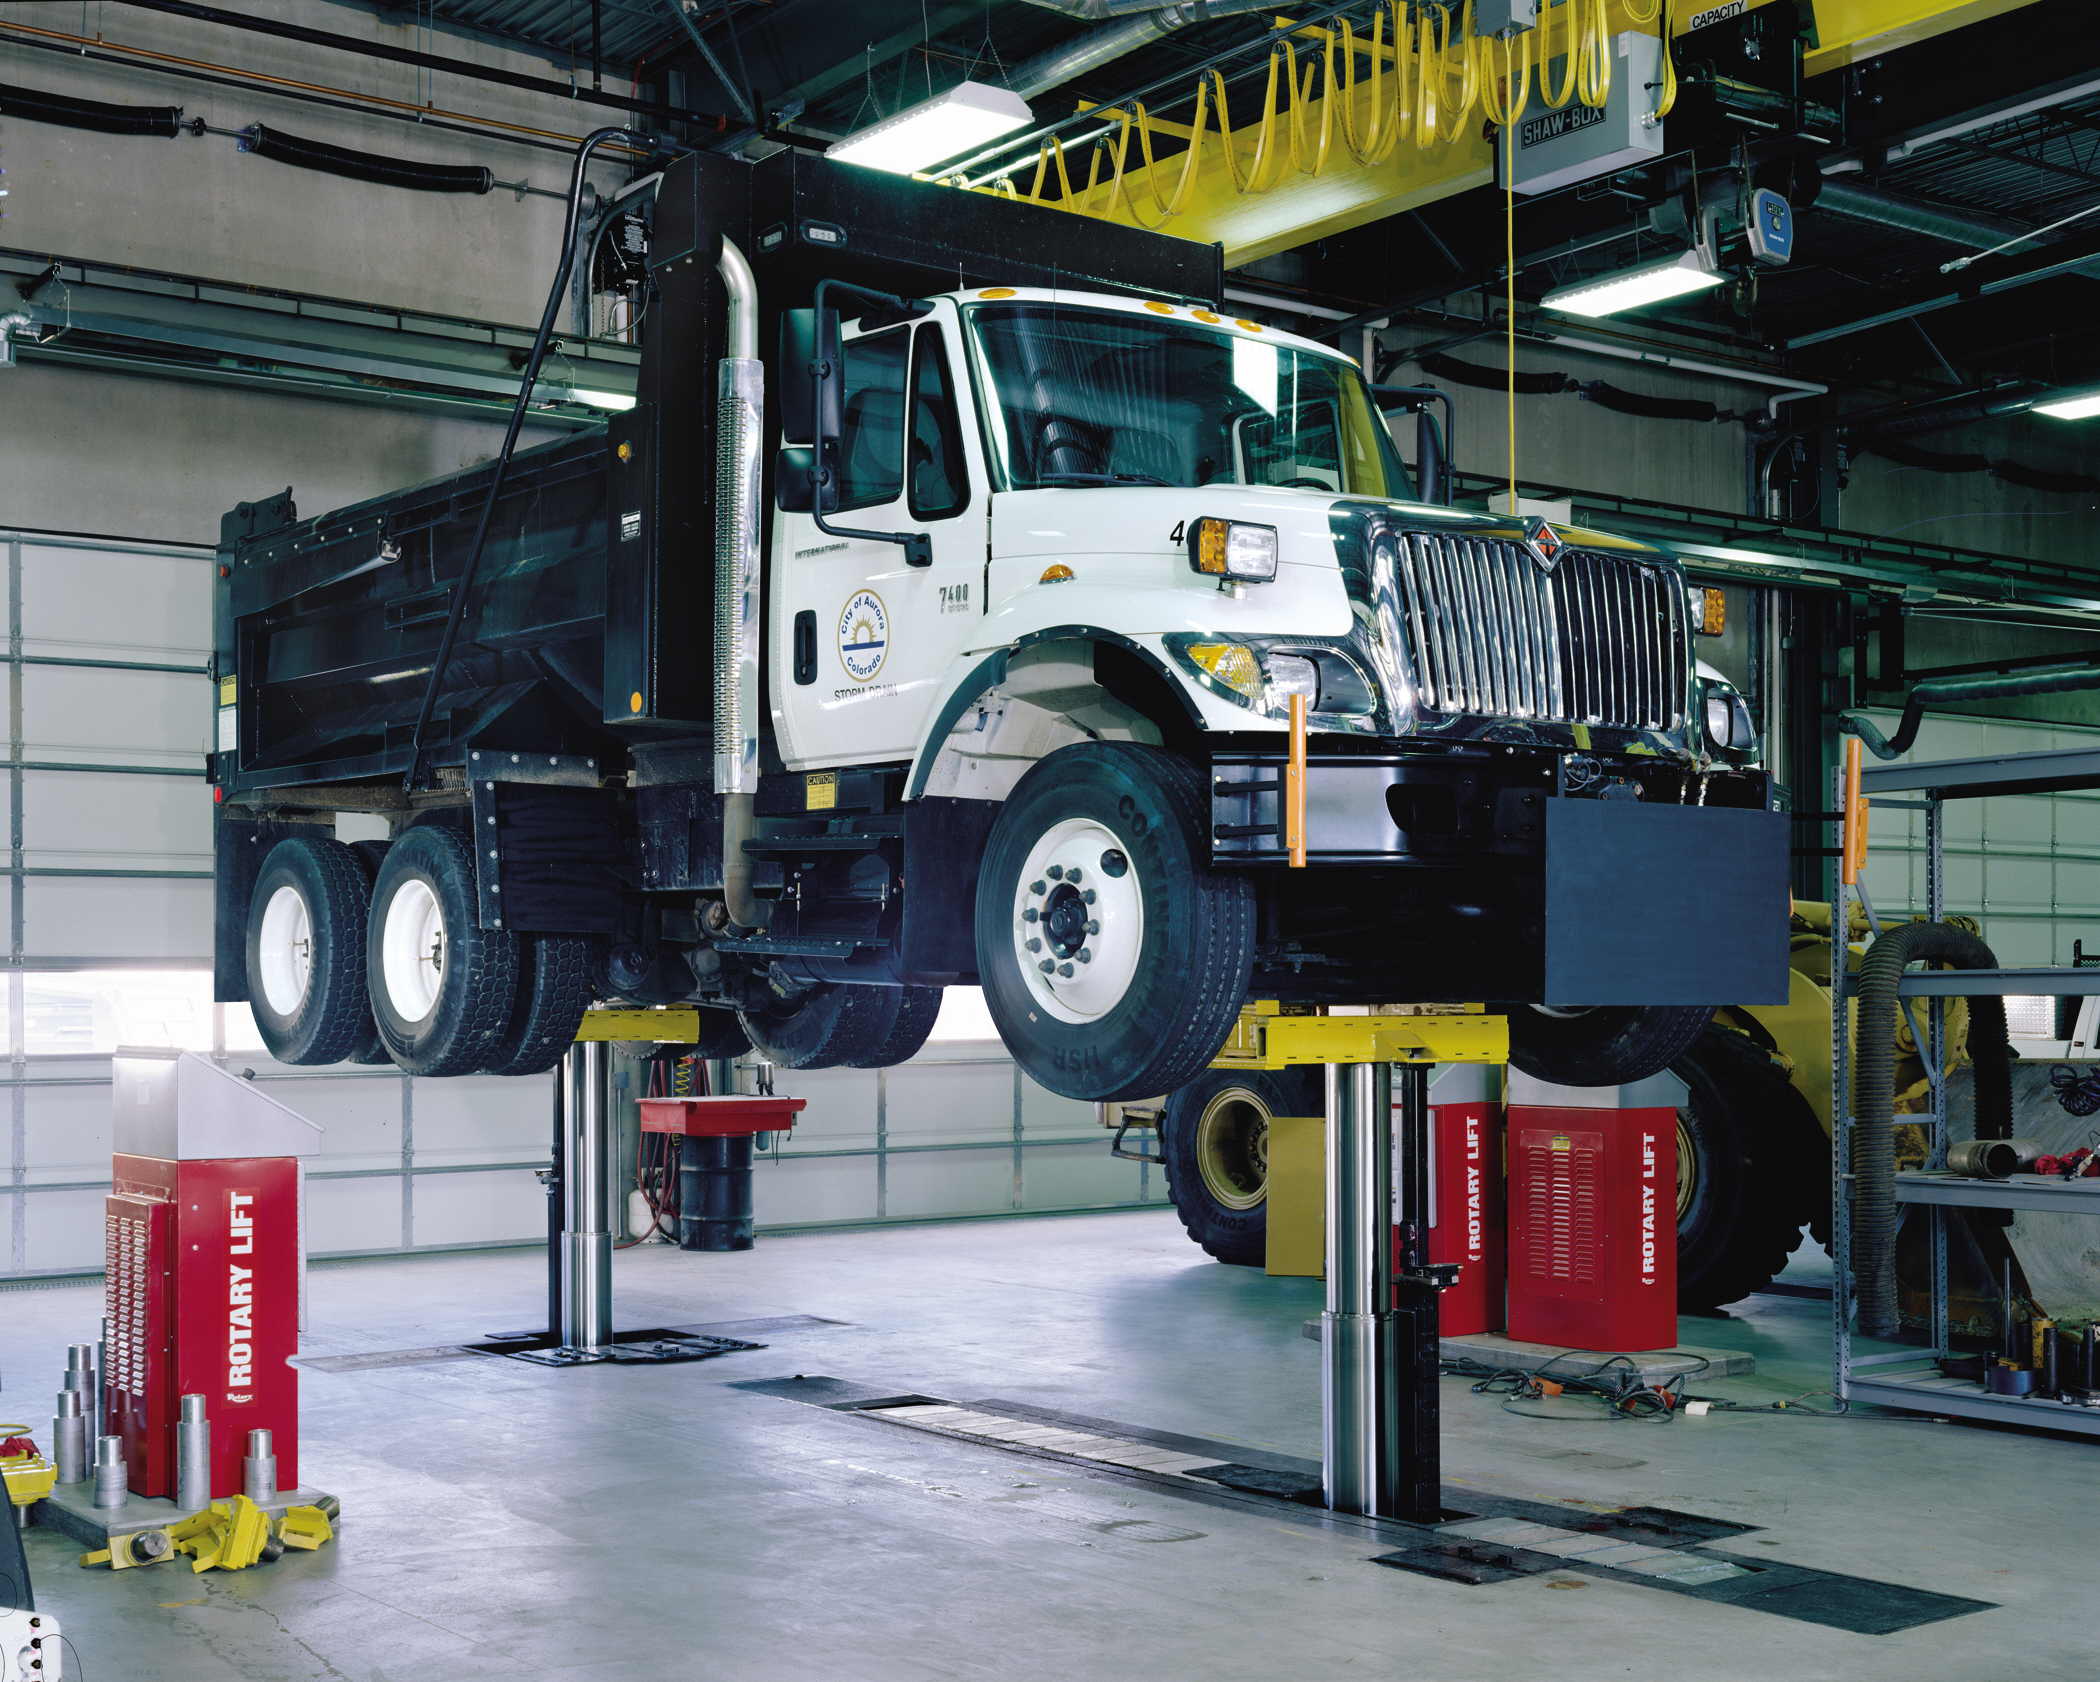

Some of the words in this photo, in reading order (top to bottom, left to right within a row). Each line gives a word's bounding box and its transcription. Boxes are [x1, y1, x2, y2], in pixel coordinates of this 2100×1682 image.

[1692, 0, 1744, 28] CAPACITY
[1524, 105, 1601, 144] SHAW-BOX
[1169, 520, 1185, 546] 4
[841, 609, 853, 634] City
[854, 597, 862, 609] of
[864, 596, 885, 630] Aurora
[847, 654, 881, 675] Colorado
[1467, 1115, 1479, 1159] LIFT
[1643, 1132, 1655, 1178] LIFT
[230, 1191, 253, 1255] LIFT
[1468, 1166, 1480, 1250] ROTARY
[1642, 1185, 1655, 1273] ROTARY
[228, 1264, 253, 1387] ROTARY
